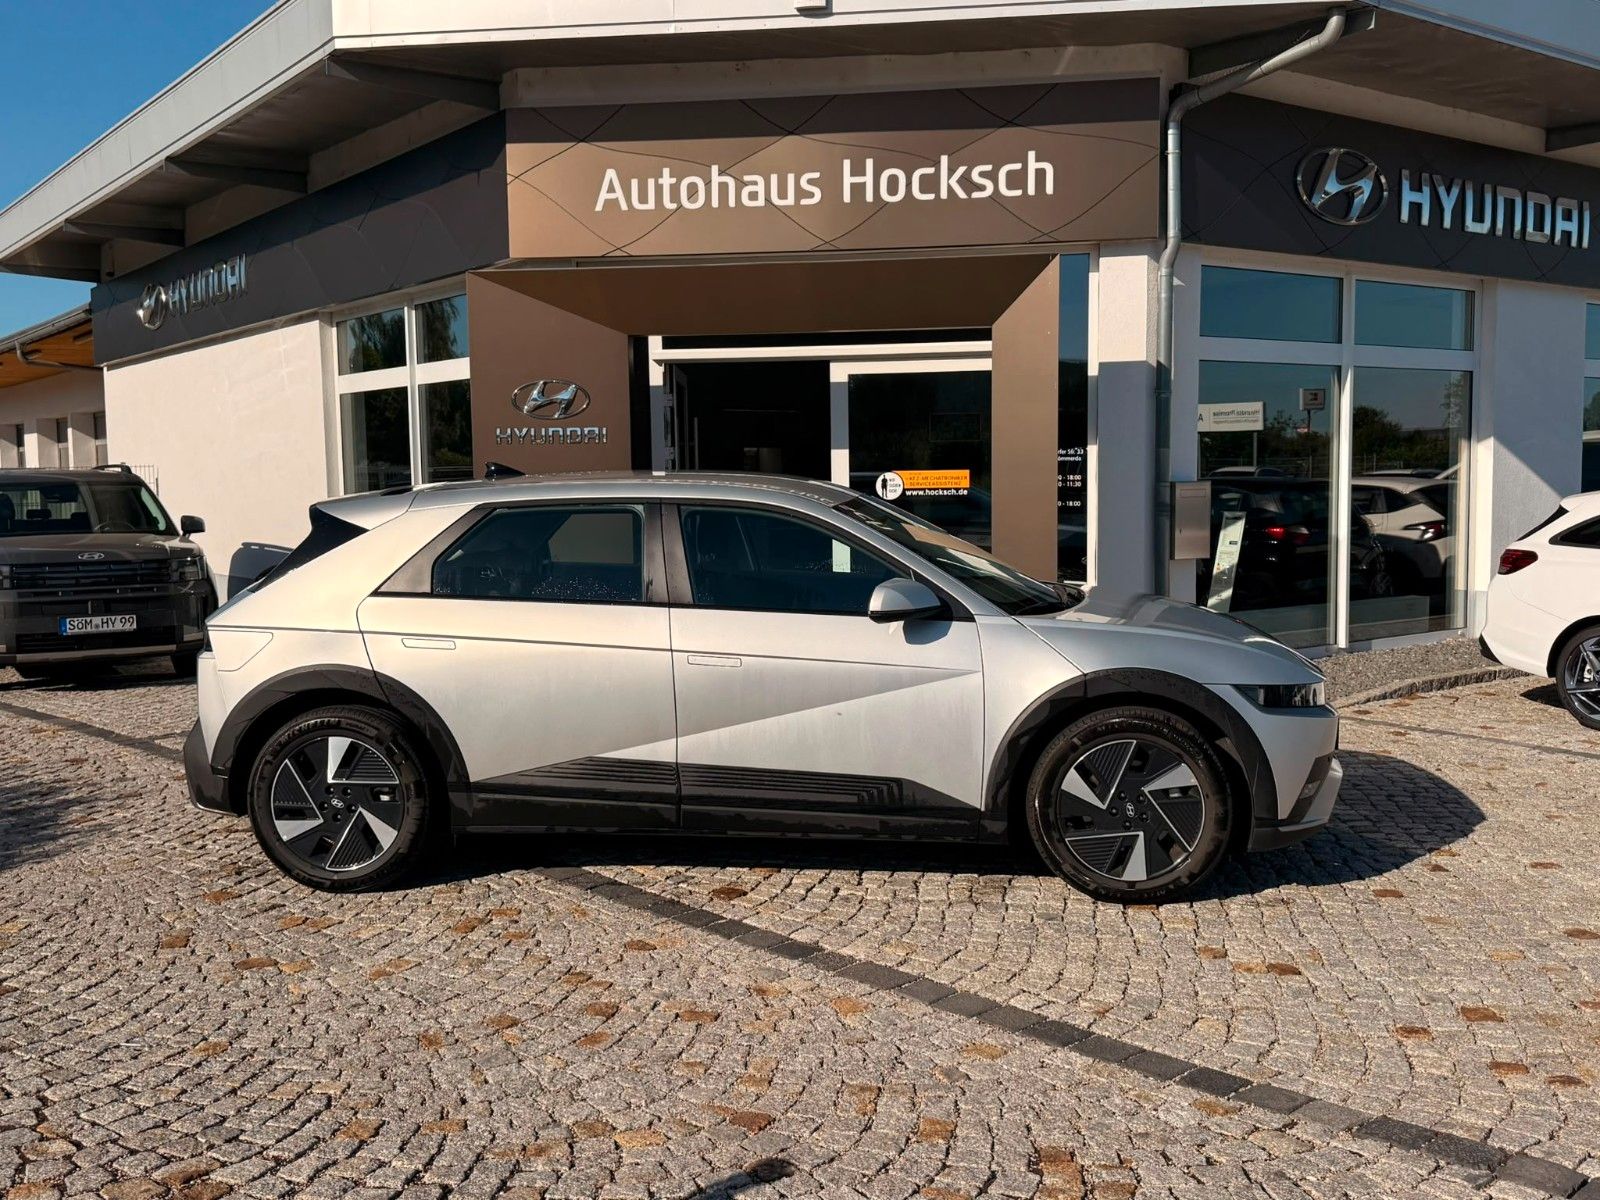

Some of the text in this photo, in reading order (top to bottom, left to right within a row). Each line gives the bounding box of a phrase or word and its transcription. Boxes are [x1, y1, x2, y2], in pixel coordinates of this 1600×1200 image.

[595, 151, 1054, 212] Autohaus Hocksch
[1399, 168, 1590, 249] HYUNDAI
[168, 253, 247, 316] HYUNDAI
[496, 426, 607, 445] HYUNDAI
[101, 617, 117, 629] HY
[119, 616, 135, 628] 99
